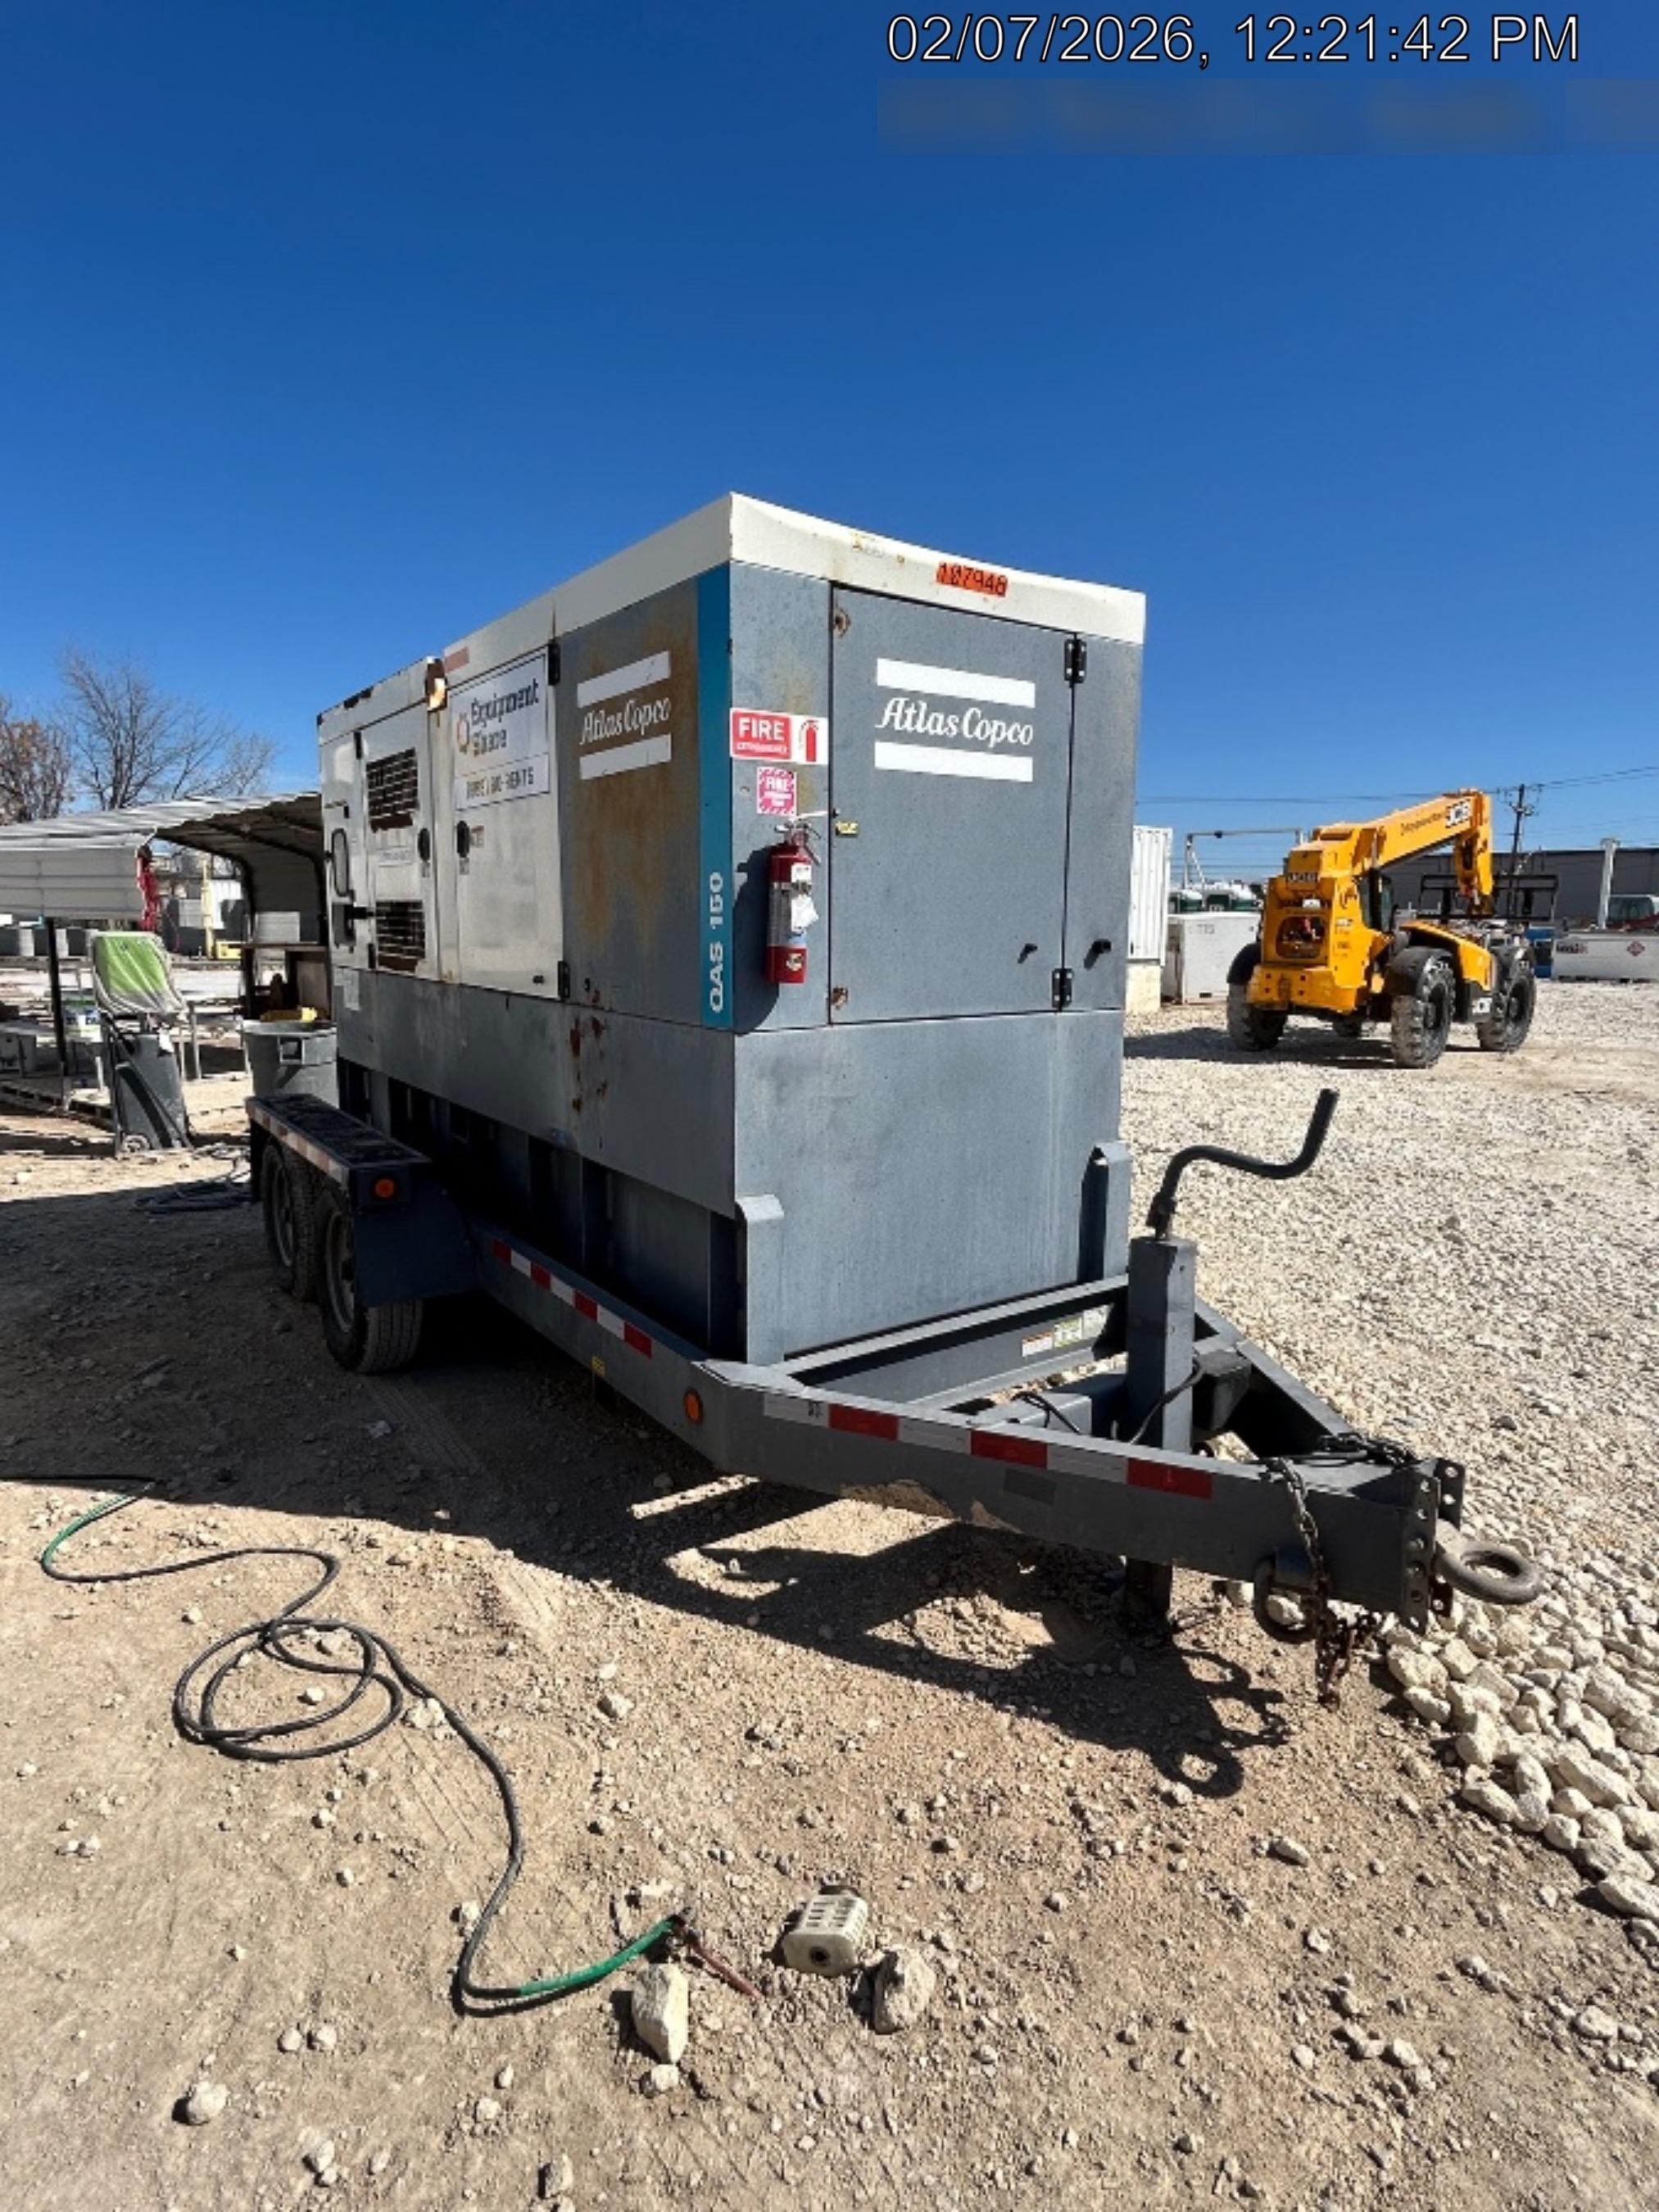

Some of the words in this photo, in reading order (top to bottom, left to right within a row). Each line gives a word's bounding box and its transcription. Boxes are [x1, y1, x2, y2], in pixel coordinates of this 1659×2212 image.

[579, 709, 623, 746] Atlas
[624, 697, 671, 736] Copco
[738, 717, 785, 741] FIRE
[875, 697, 959, 738] Atlas
[962, 707, 1034, 749] Copco
[709, 872, 723, 930] 150
[709, 941, 723, 1013] QAS
